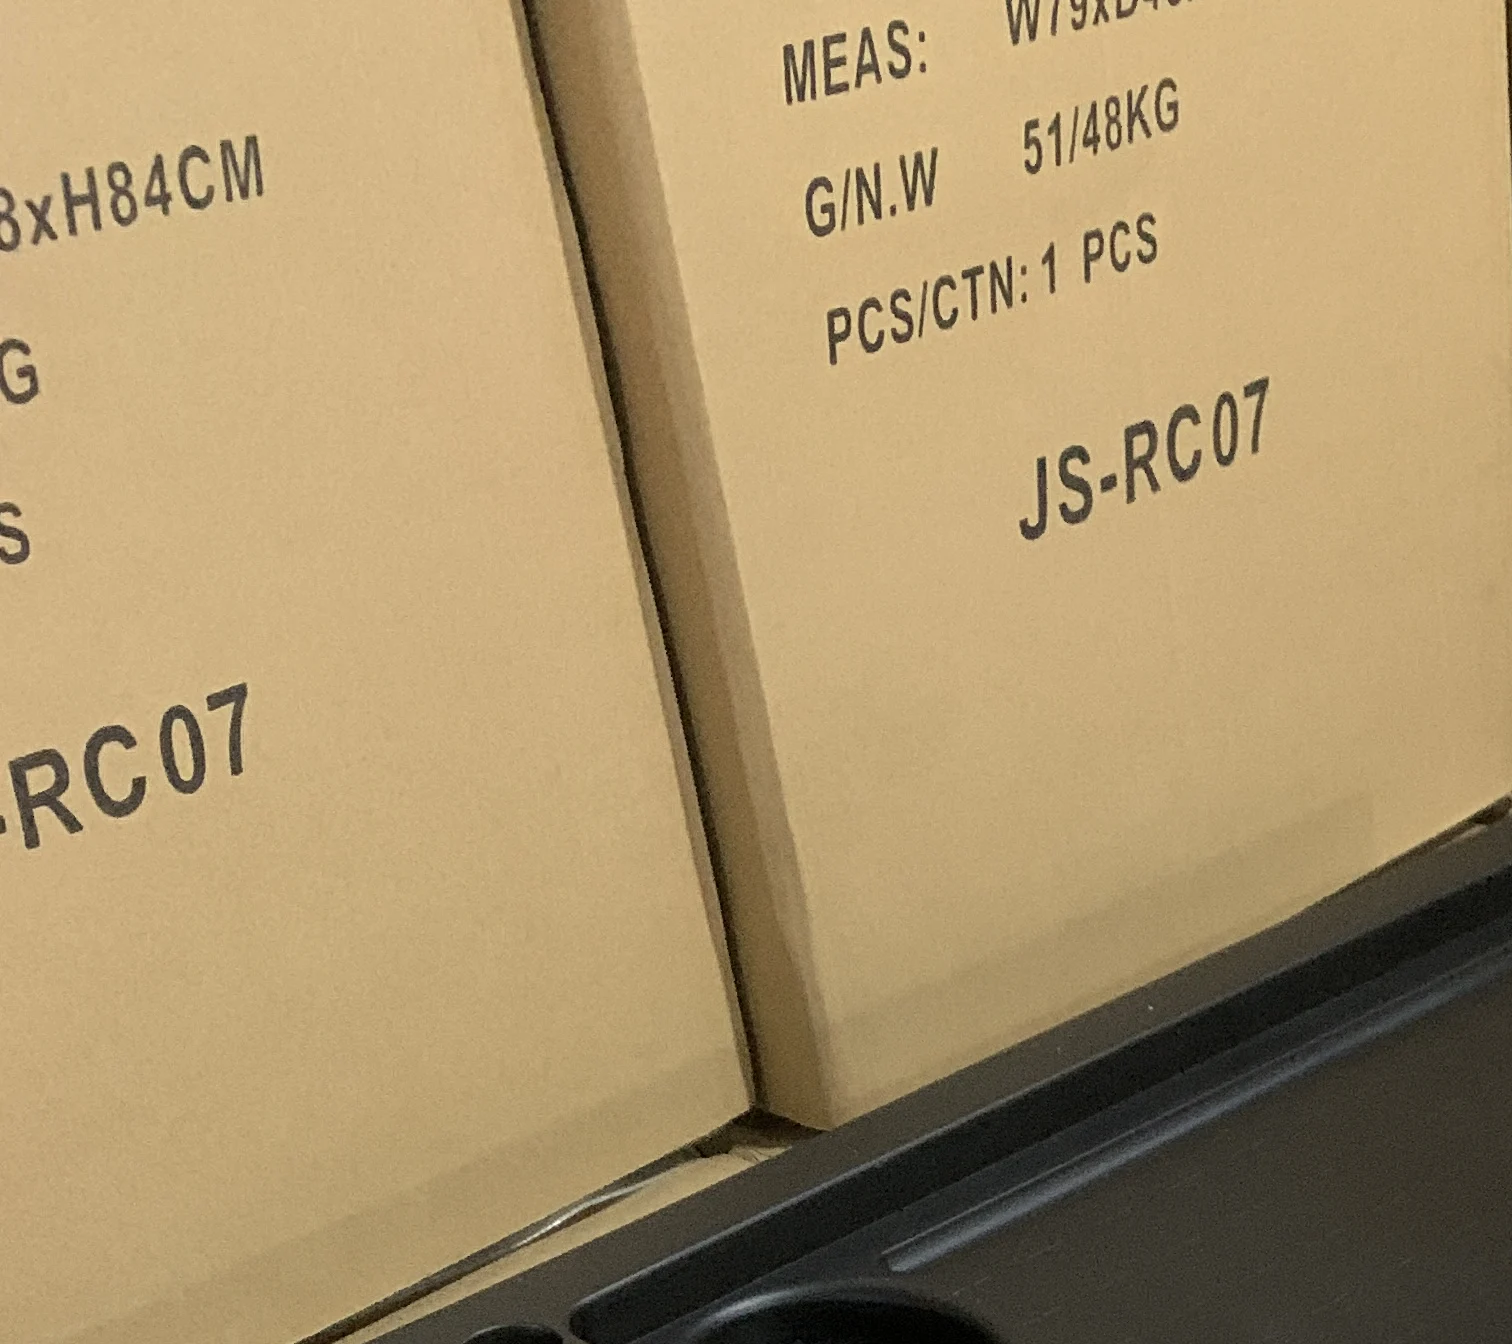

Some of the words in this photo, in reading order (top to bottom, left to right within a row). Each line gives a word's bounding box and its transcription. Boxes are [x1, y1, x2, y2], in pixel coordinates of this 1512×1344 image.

[783, 19, 928, 105] MEAS:
[804, 148, 939, 237] G/N.W
[1023, 77, 1180, 175] 51/48KG
[826, 256, 1028, 366] PCS/CTN:
[1041, 241, 1057, 294] 1
[1082, 212, 1158, 284] PCS
[1020, 376, 1270, 541] JS-RC07
[0, 682, 249, 849] RC07
